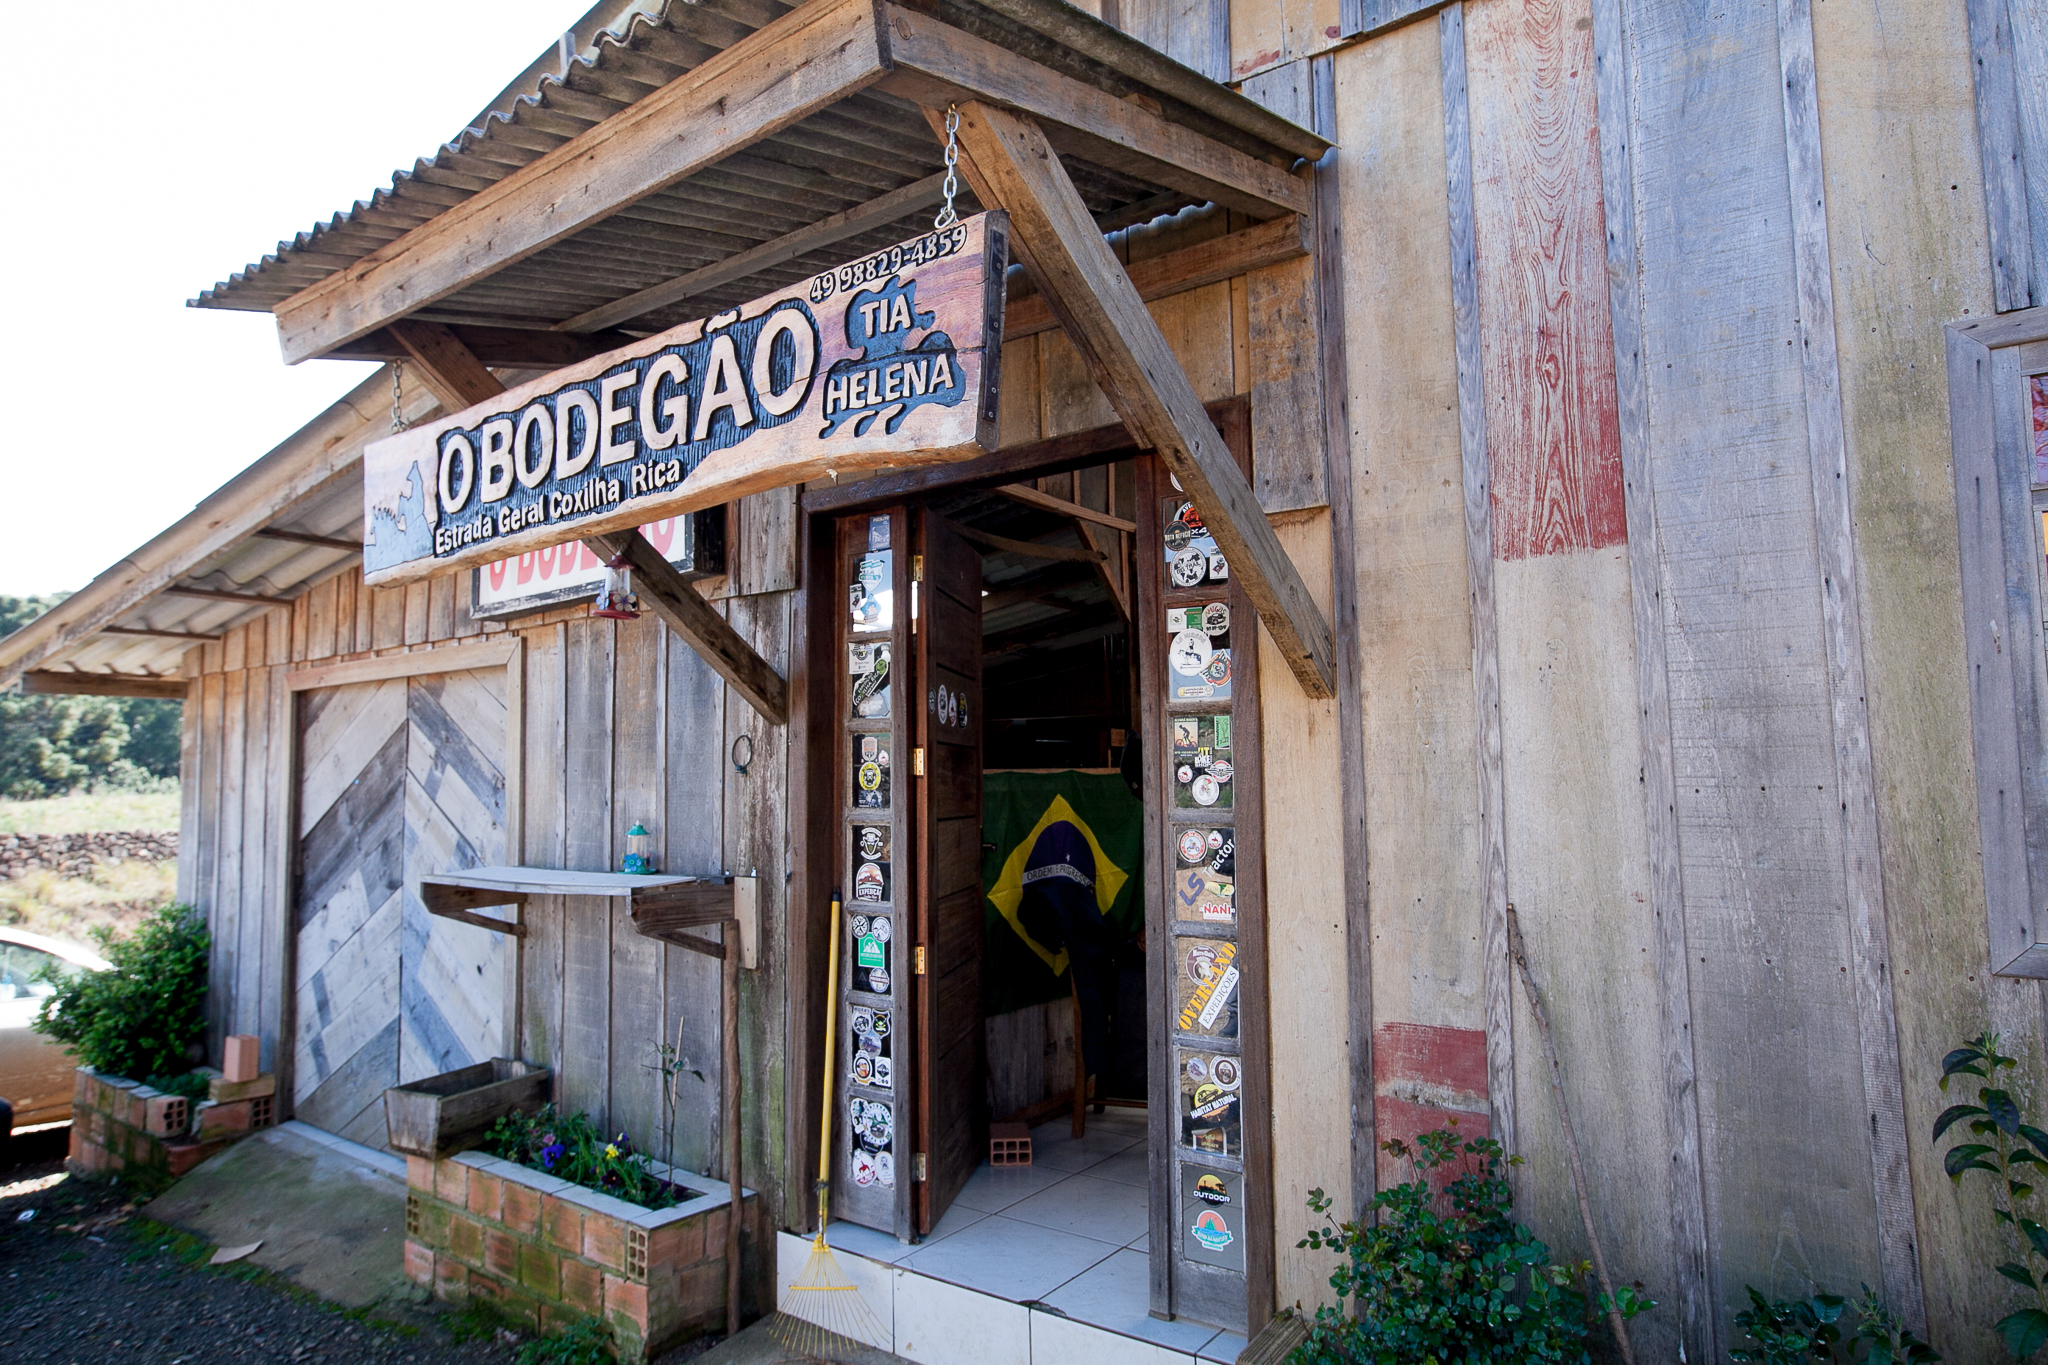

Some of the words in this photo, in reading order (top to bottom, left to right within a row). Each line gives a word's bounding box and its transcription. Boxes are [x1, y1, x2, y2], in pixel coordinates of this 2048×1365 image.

[811, 276, 835, 301] 49
[840, 225, 967, 290] 98829-4859
[860, 294, 911, 338] TIA
[827, 353, 954, 414] HELENA
[438, 434, 474, 513] O
[480, 308, 814, 504] BODEGÃO
[435, 513, 493, 555] Estrada
[498, 494, 544, 534] Geral
[549, 477, 620, 519] Coxilha
[631, 458, 680, 495] Rica
[1026, 866, 1053, 882] ORDEM
[1055, 864, 1059, 874] E
[1202, 838, 1236, 878] Tractor
[1203, 903, 1232, 915] NANI
[1178, 942, 1237, 1030] OVERLAND
[1202, 970, 1237, 1025] EXPEDIÇÕES
[1190, 1102, 1213, 1119] HABITAT
[1211, 1093, 1238, 1110] NATURAL
[1193, 1190, 1231, 1203] OUTDOOR
